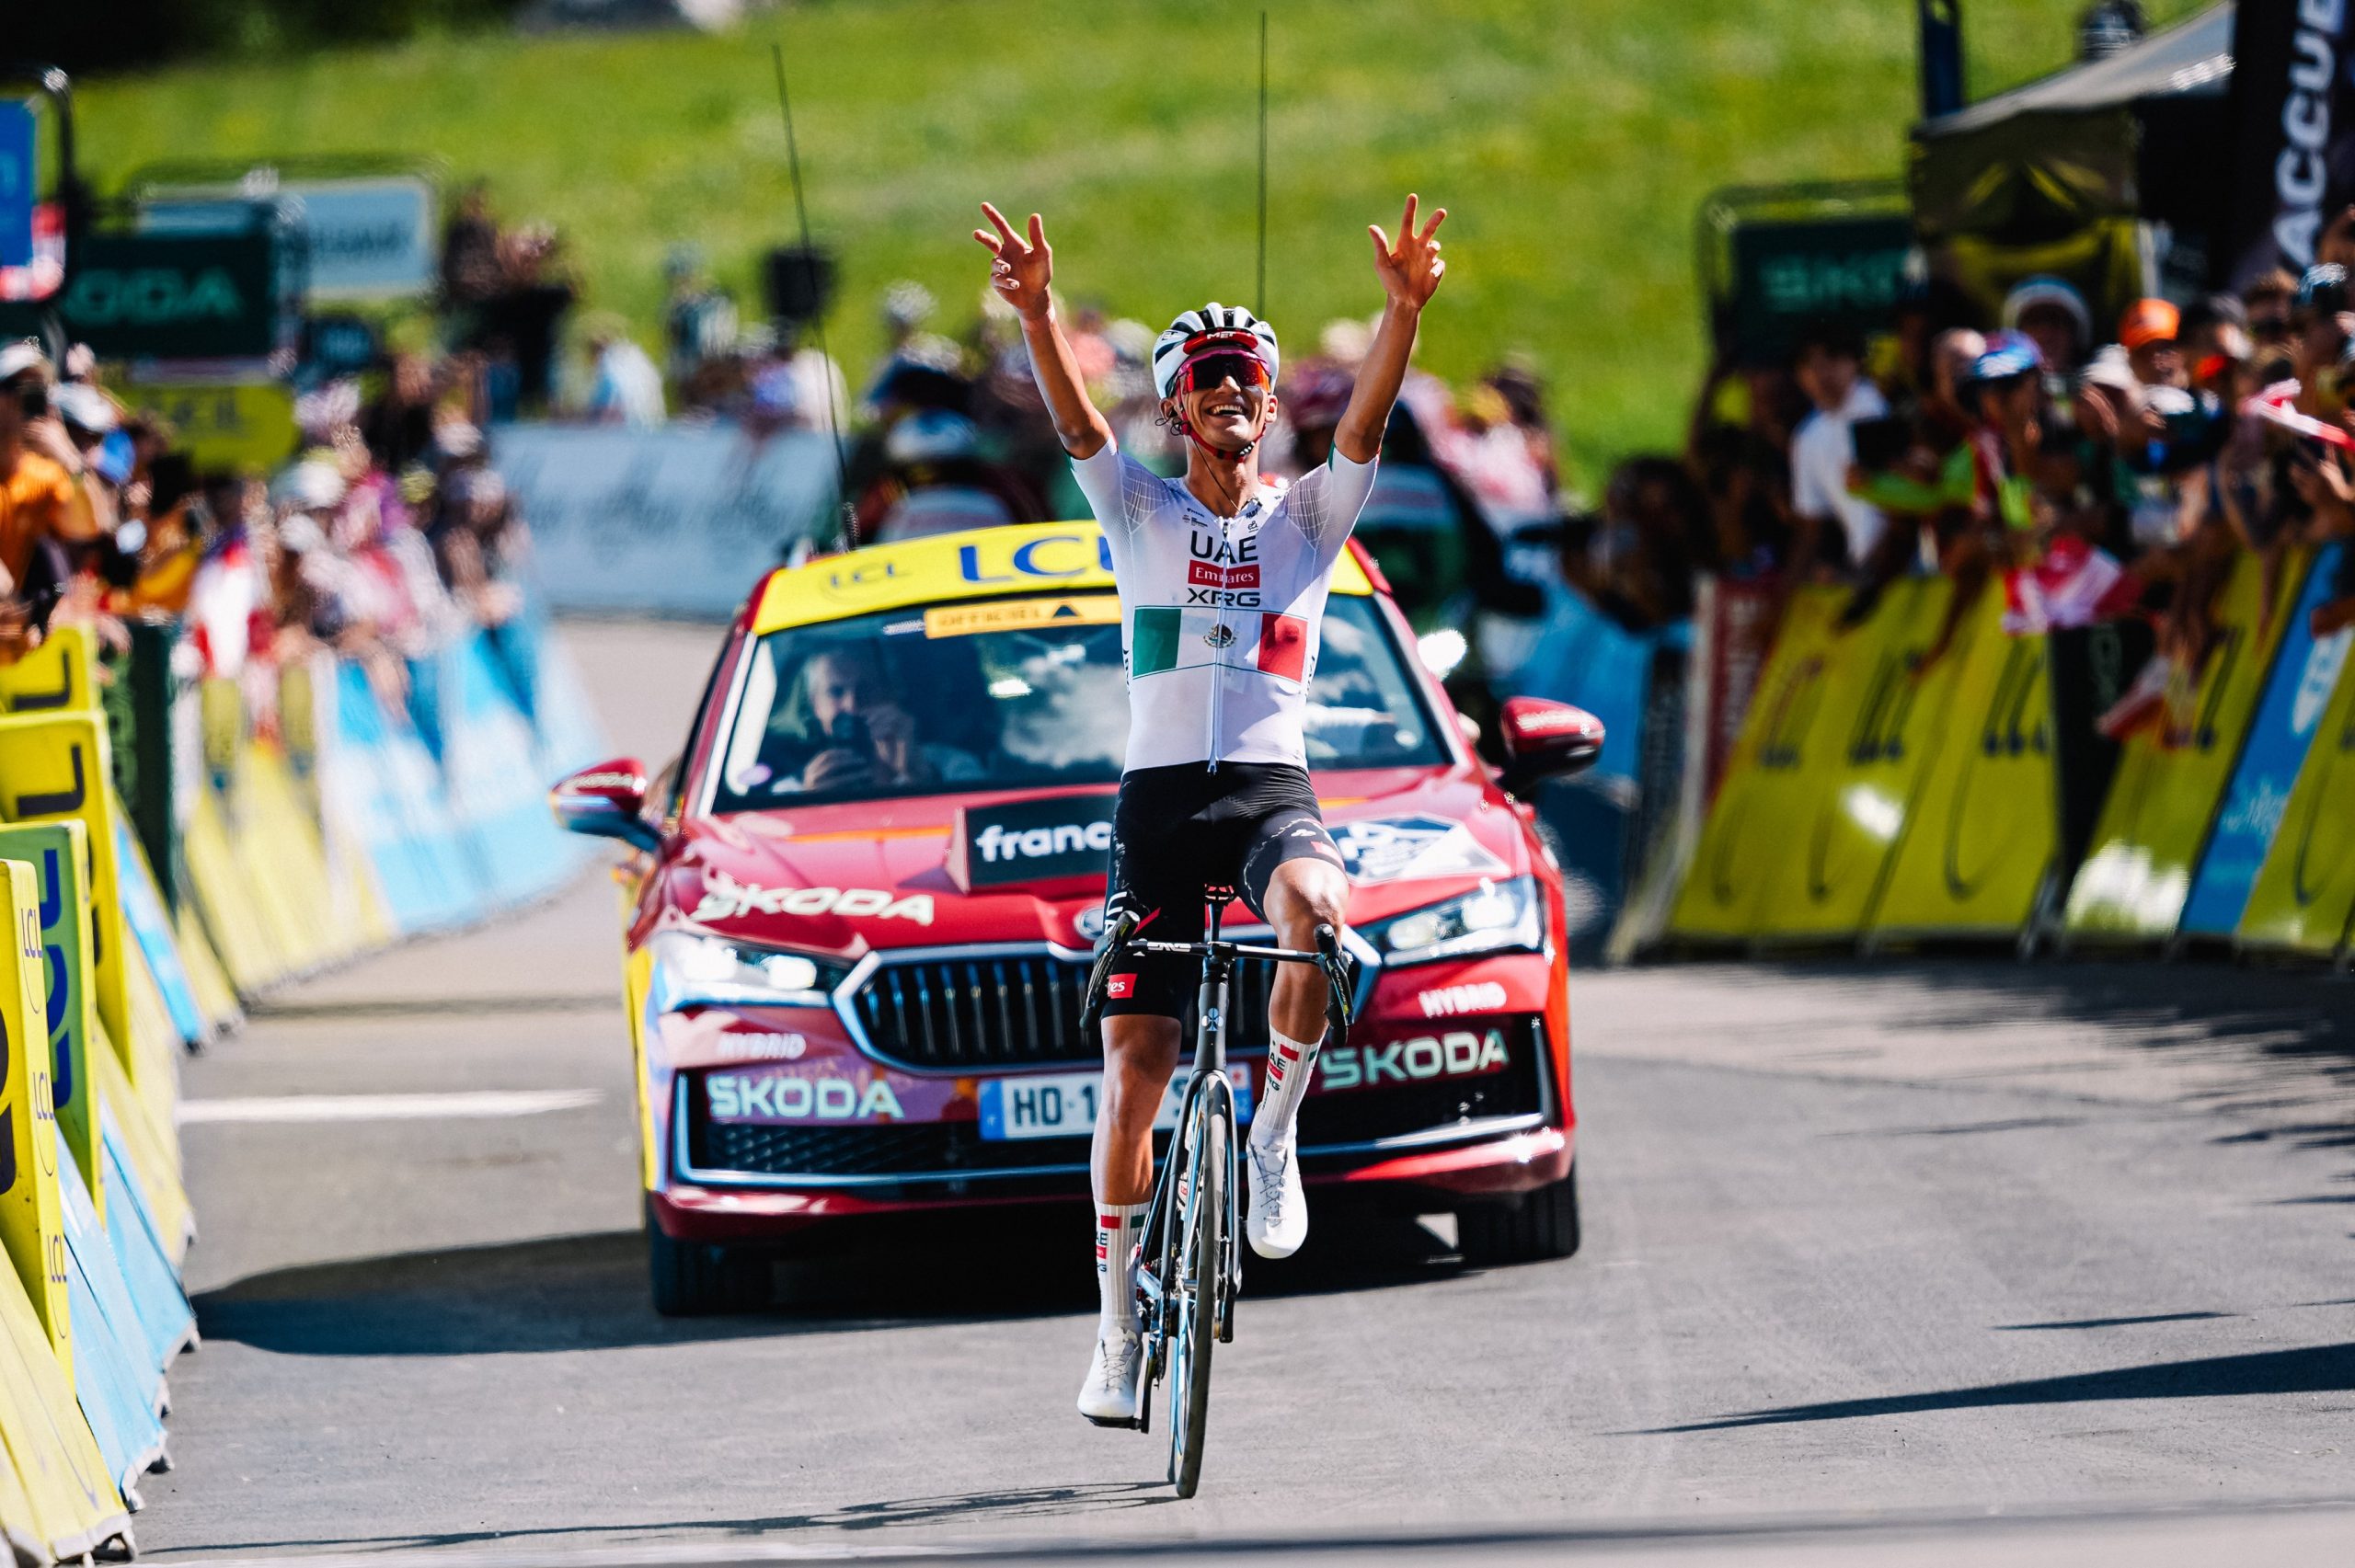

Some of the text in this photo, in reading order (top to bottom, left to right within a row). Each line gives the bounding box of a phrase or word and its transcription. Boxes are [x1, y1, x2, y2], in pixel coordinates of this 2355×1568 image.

[1207, 330, 1236, 339] MET
[1190, 529, 1259, 565] UAE
[1195, 567, 1255, 584] Emirates
[1187, 587, 1261, 607] XRG
[20, 908, 43, 958] LCL
[1419, 981, 1507, 1018] HYBRID
[33, 1071, 54, 1120] LCL
[47, 1234, 67, 1283] LCL
